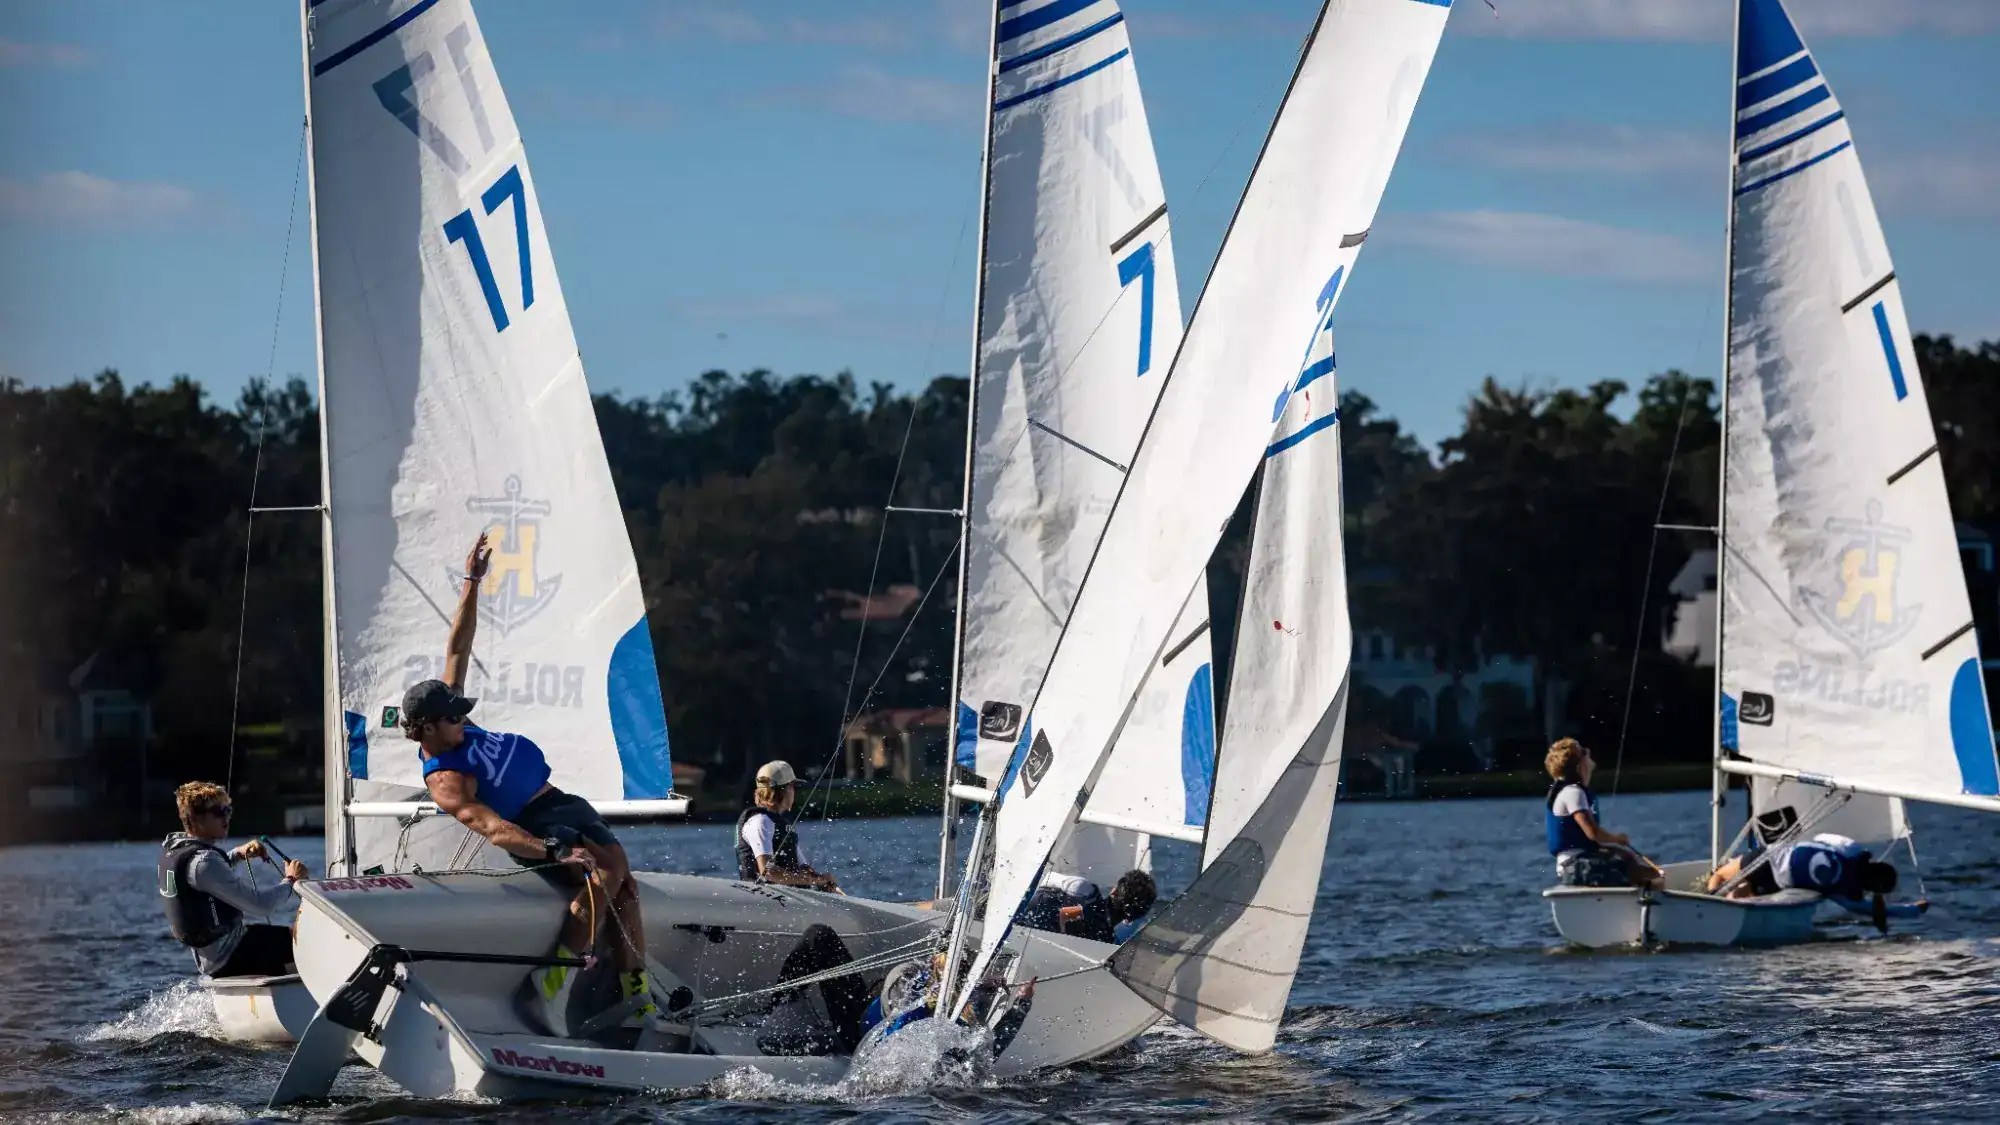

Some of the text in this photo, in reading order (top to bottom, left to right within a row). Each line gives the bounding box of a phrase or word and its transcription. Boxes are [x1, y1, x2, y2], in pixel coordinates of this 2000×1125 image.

[443, 164, 534, 333] 17
[1117, 241, 1155, 378] 7
[1871, 300, 1908, 402] 1
[491, 1047, 604, 1078] Marlow
